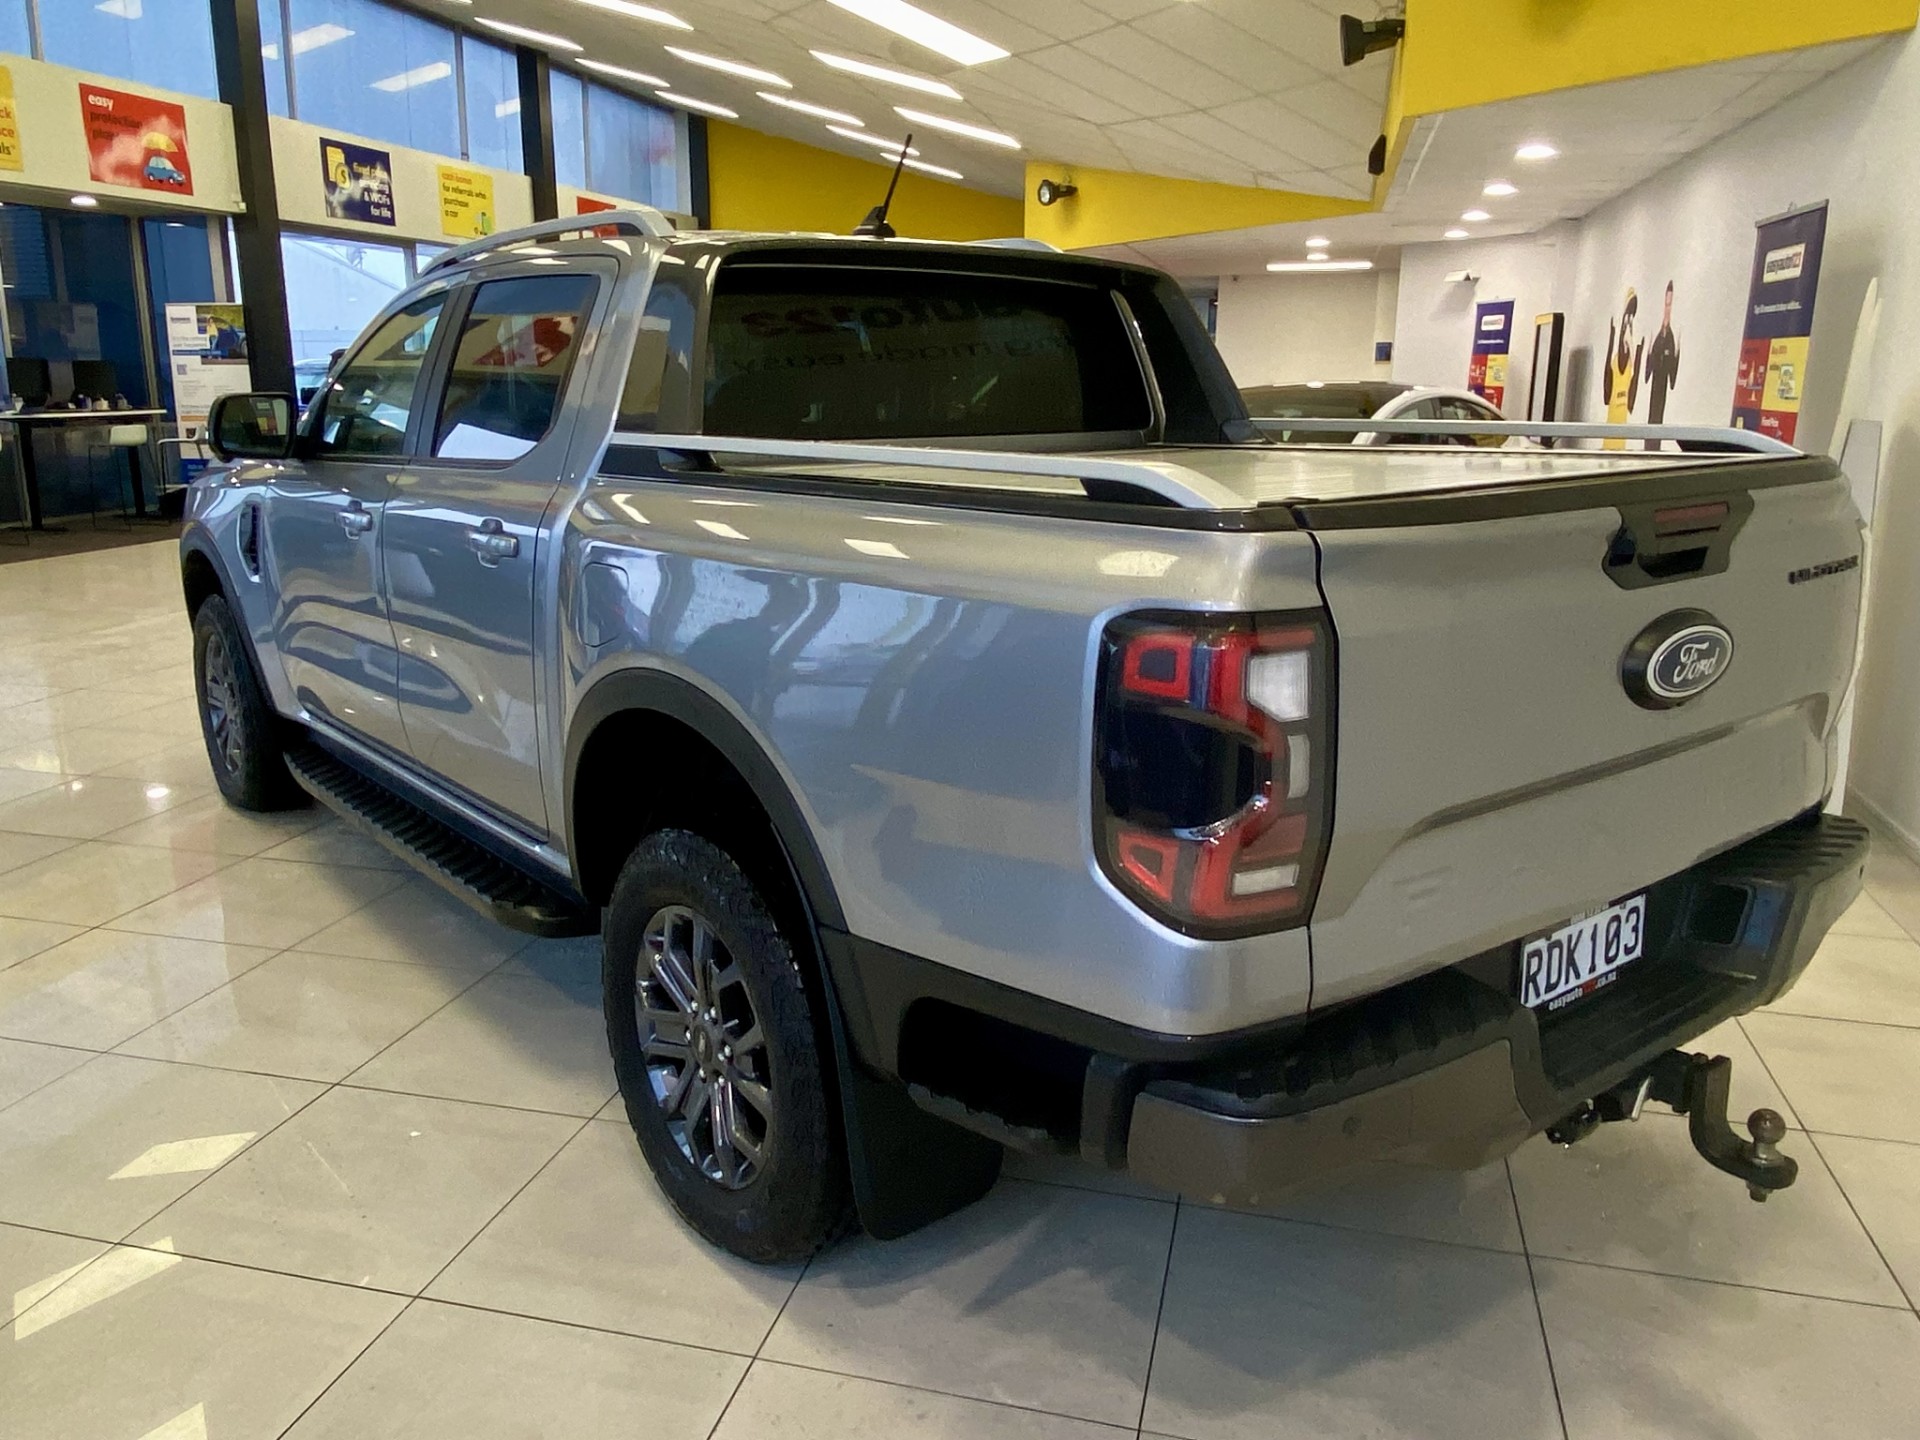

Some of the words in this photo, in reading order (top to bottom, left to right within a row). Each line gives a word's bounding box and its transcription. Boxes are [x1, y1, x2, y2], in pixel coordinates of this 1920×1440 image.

[88, 94, 113, 111] easy
[90, 112, 142, 128] protection
[371, 204, 380, 216] for
[381, 207, 391, 219] life
[1673, 641, 1720, 684] Ford
[1523, 905, 1641, 1004] RDK103
